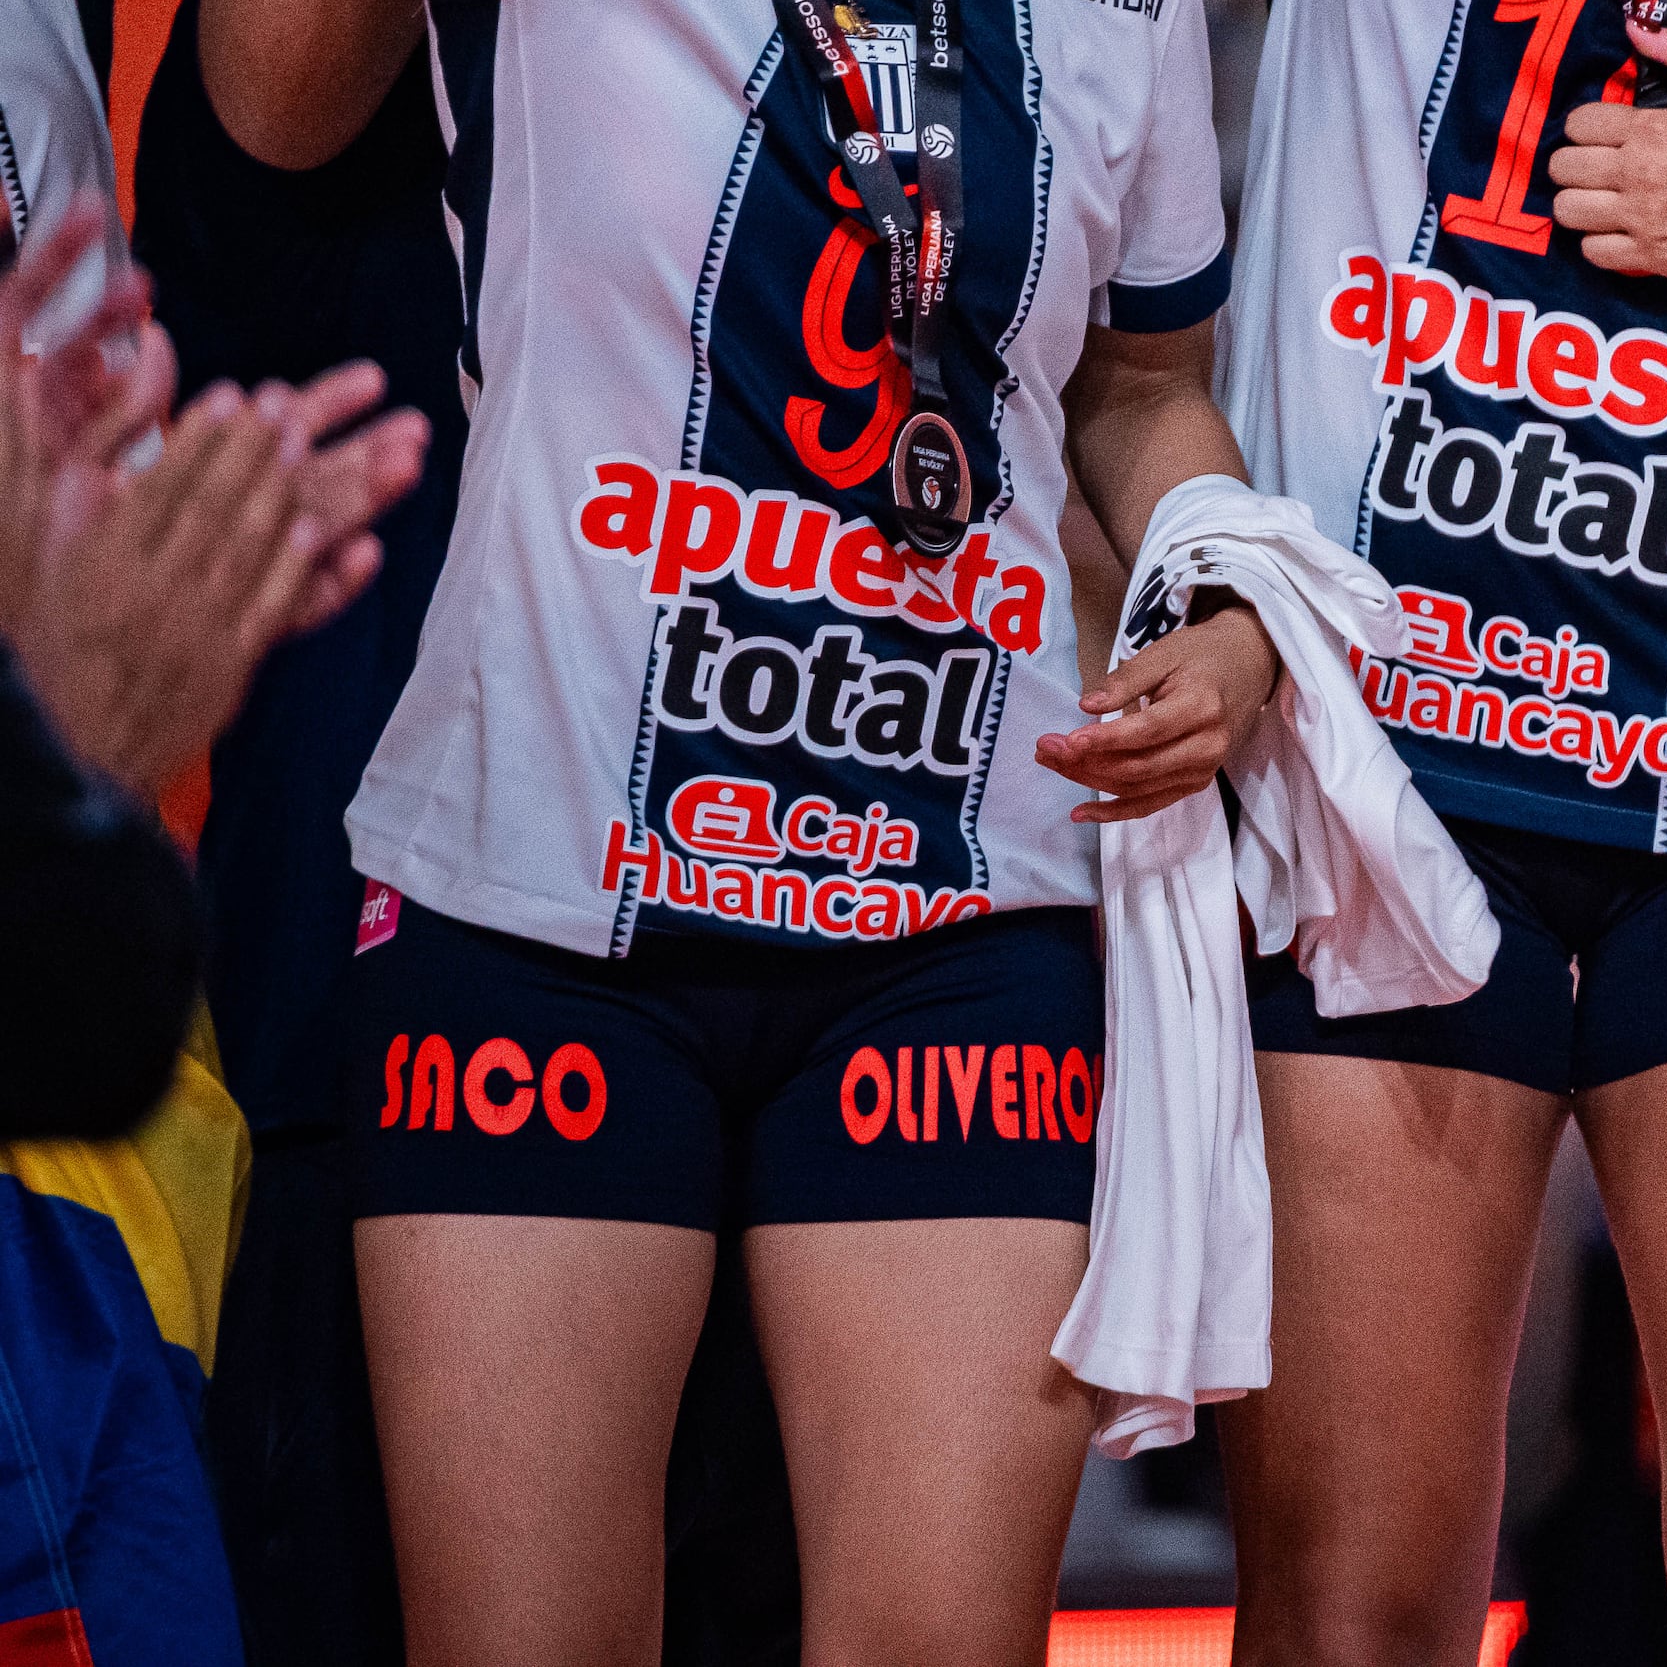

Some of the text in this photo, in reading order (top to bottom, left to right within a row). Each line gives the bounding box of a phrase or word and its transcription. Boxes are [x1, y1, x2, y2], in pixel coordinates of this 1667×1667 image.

[1650, 0, 1667, 22] DE
[882, 213, 904, 319] LIGA PERUANA
[920, 210, 942, 317] LIGA PERUANA
[934, 282, 947, 302] DE
[784, 214, 914, 491] 9
[580, 461, 1046, 655] apuesta
[660, 605, 988, 766] total
[1481, 619, 1606, 694] Caja
[786, 799, 914, 872] Caja
[380, 1033, 608, 1141] SACO
[840, 1044, 1103, 1145] OLIVERO
